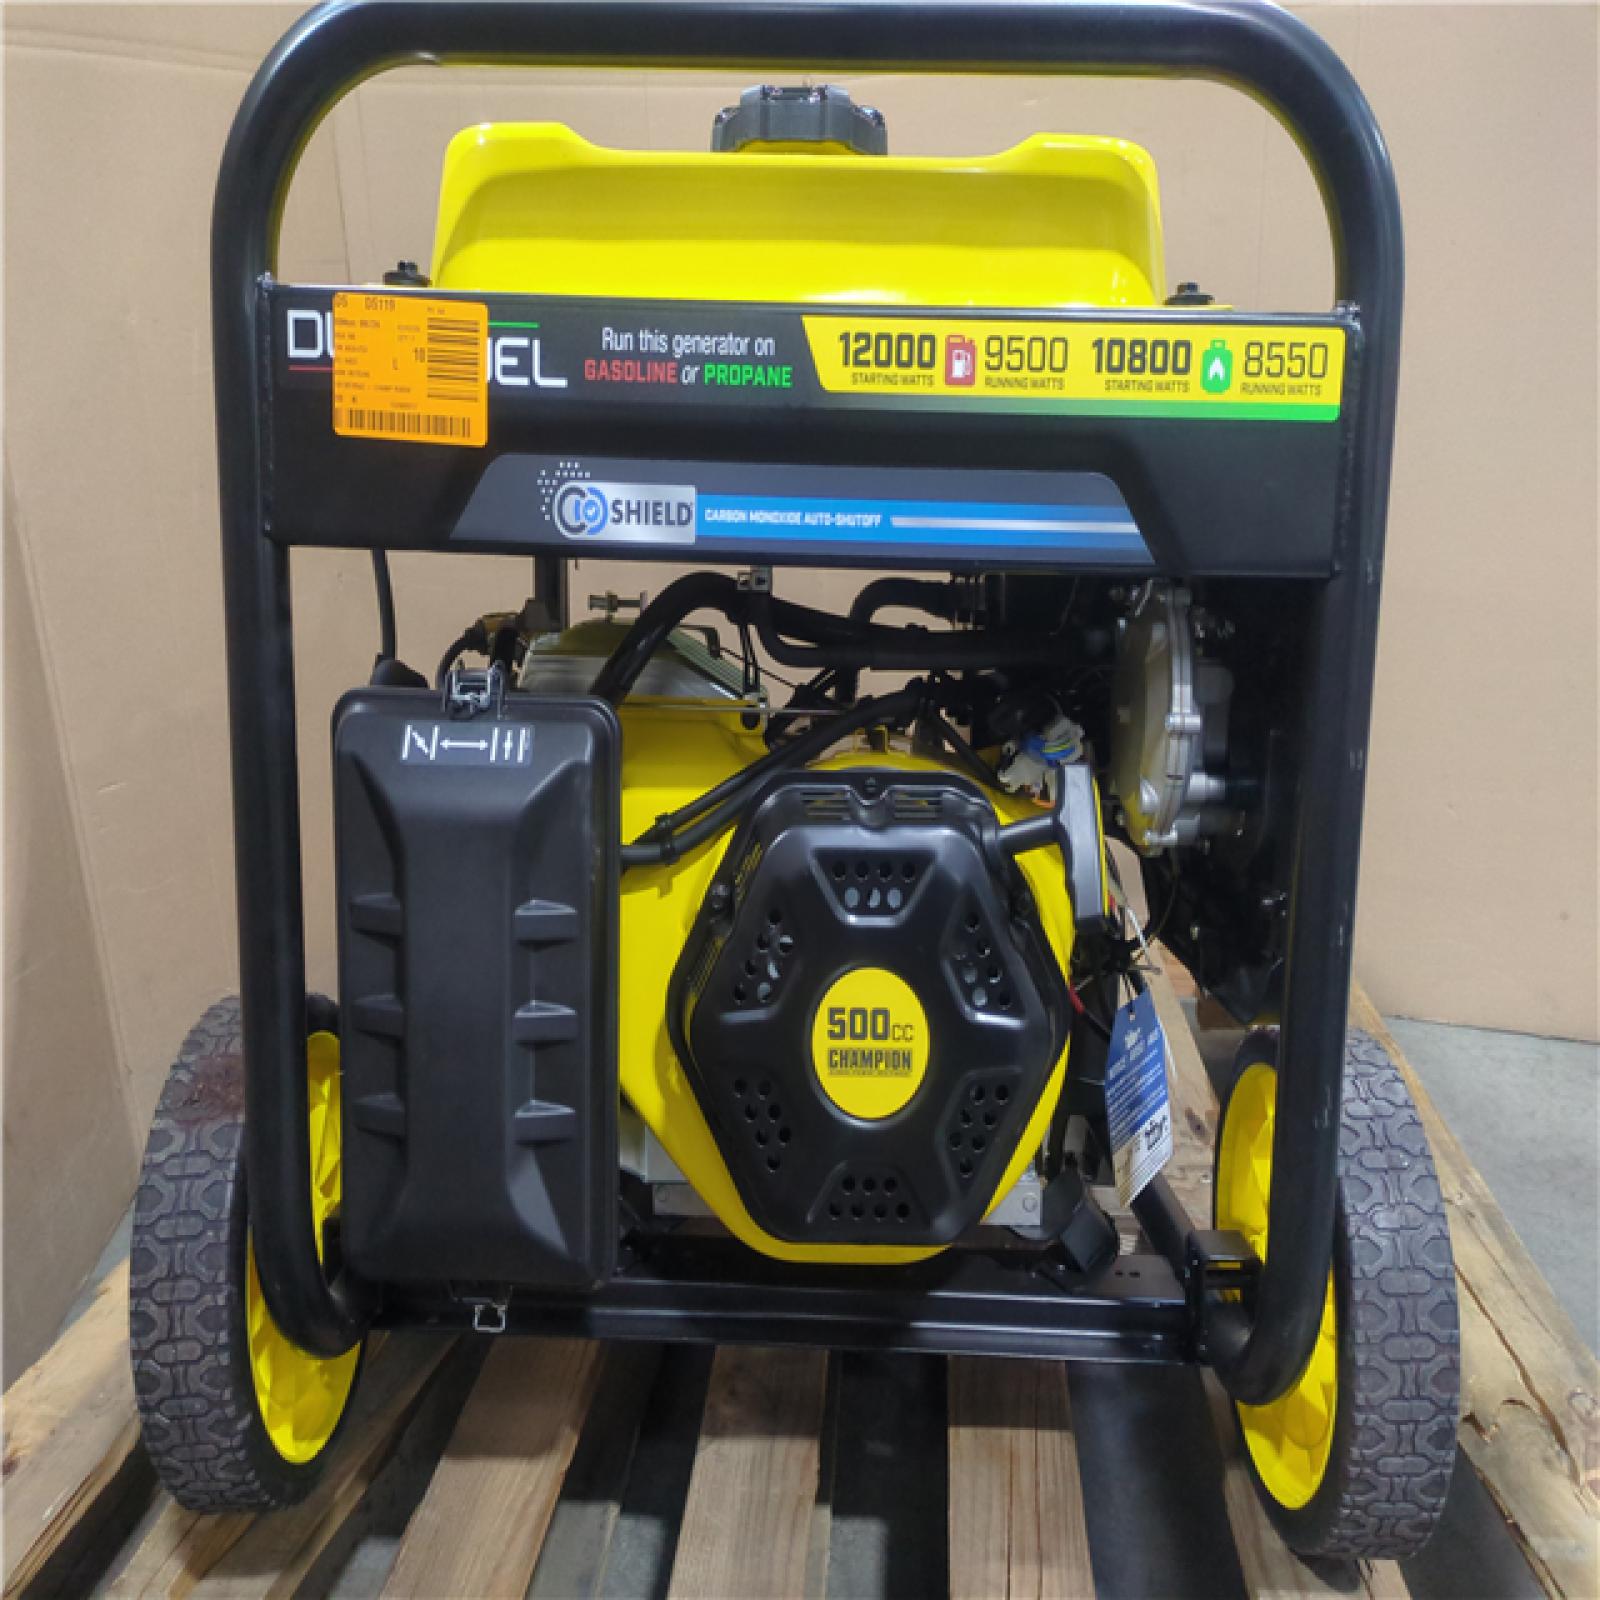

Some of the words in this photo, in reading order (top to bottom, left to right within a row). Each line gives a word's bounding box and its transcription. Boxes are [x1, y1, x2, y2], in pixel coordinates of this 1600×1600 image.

[286, 309, 335, 358] D
[487, 336, 568, 388] EL
[602, 326, 634, 351] Run
[638, 328, 668, 353] this
[672, 331, 750, 358] generator
[754, 336, 776, 356] on
[838, 331, 936, 369] 12000
[984, 335, 1068, 373] 9500
[1092, 337, 1192, 375] 10800
[584, 358, 678, 384] GASOLINE
[680, 364, 700, 385] or
[703, 362, 793, 389] PROPANE
[1243, 341, 1328, 379] 8550
[851, 372, 899, 386] STARTING
[900, 374, 934, 387] WATTS
[984, 376, 1028, 390] RUNNING
[1030, 377, 1065, 391] WATTS
[1104, 379, 1153, 393] STARTING
[1154, 380, 1190, 393] WATTS
[1240, 382, 1286, 396] RUNNING
[1287, 384, 1321, 397] WATTS
[610, 499, 693, 527] SHIELD
[827, 1047, 913, 1071] CHAMPION
